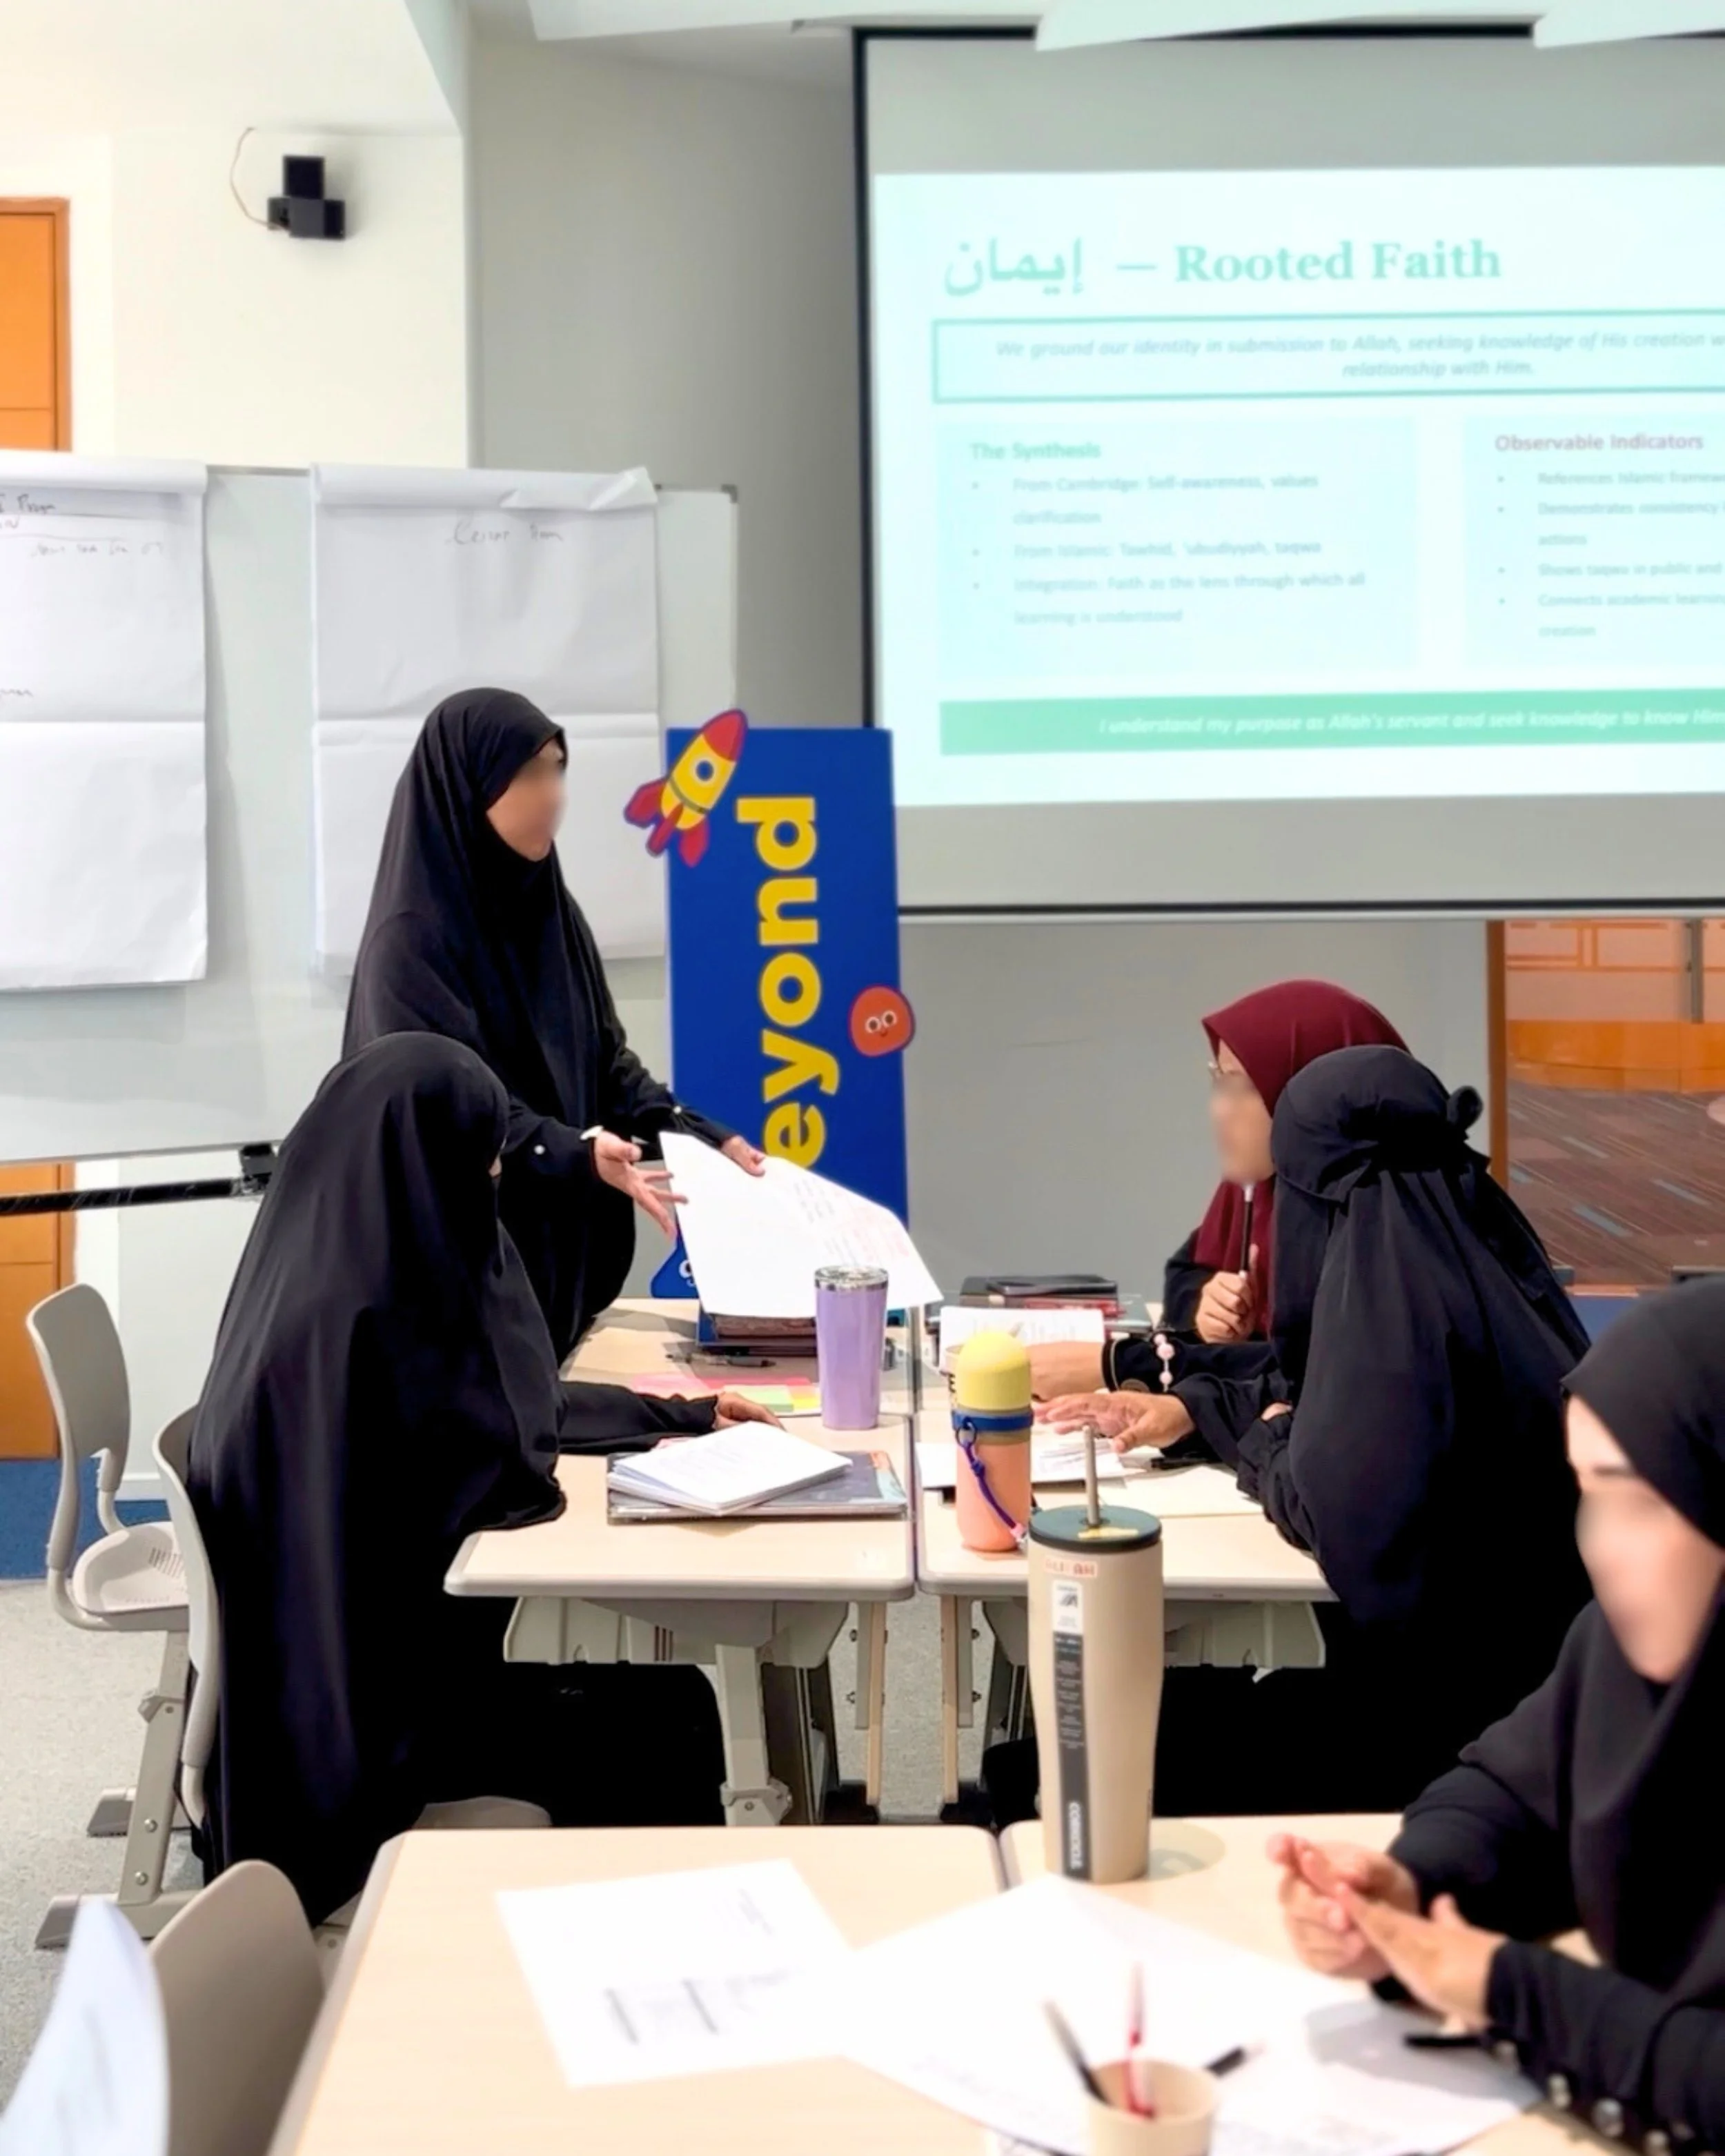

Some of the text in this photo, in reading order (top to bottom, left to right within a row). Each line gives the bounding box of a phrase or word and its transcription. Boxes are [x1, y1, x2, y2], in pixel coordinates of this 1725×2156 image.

[945, 239, 1084, 297] إيمان
[1176, 241, 1354, 283] Rooted
[1372, 239, 1501, 280] Faith
[1205, 338, 1223, 353] in
[1329, 337, 1348, 352] to
[1577, 330, 1599, 352] of
[1341, 360, 1448, 379] relationship
[1450, 359, 1490, 376] with
[969, 442, 1101, 462] The Synthesis
[1495, 432, 1704, 453] Observable Indicators
[737, 797, 840, 1169] eyond
